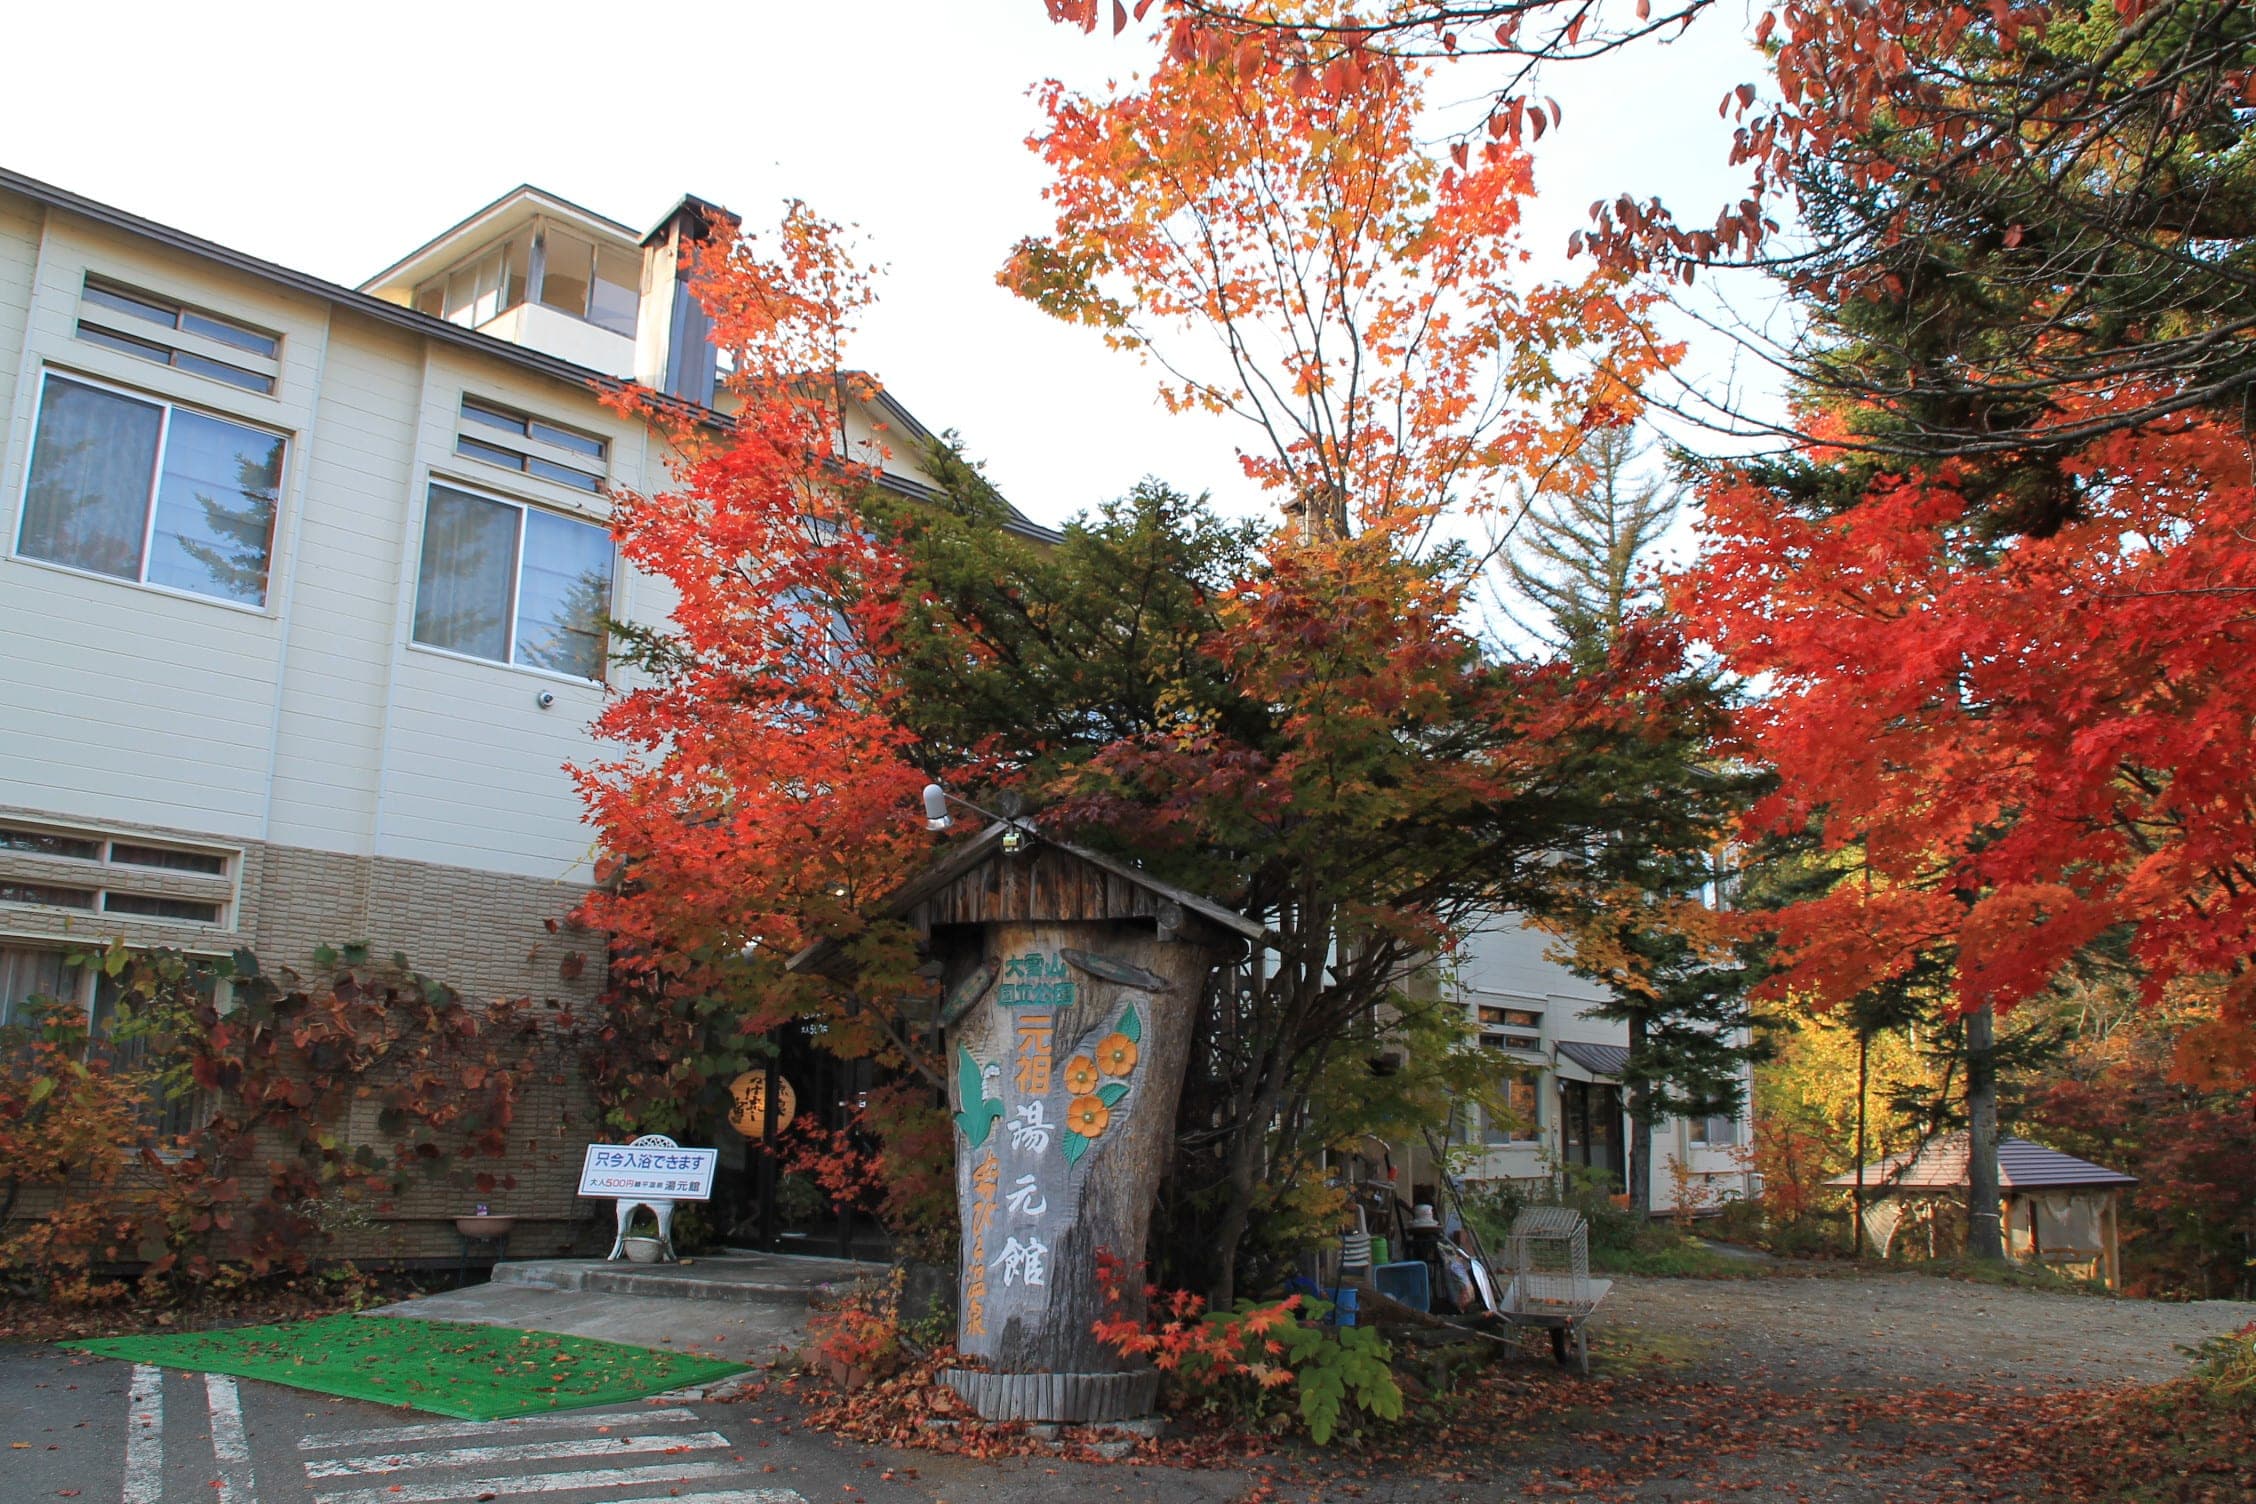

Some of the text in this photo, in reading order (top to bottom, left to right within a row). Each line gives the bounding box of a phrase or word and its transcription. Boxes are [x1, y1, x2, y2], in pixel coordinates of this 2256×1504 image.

[1005, 952, 1067, 978] 大雪山
[997, 983, 1076, 1007] 国立公園
[595, 1151, 705, 1170] 只今入浴できます
[991, 1015, 1055, 1286] 元祖 湯元館
